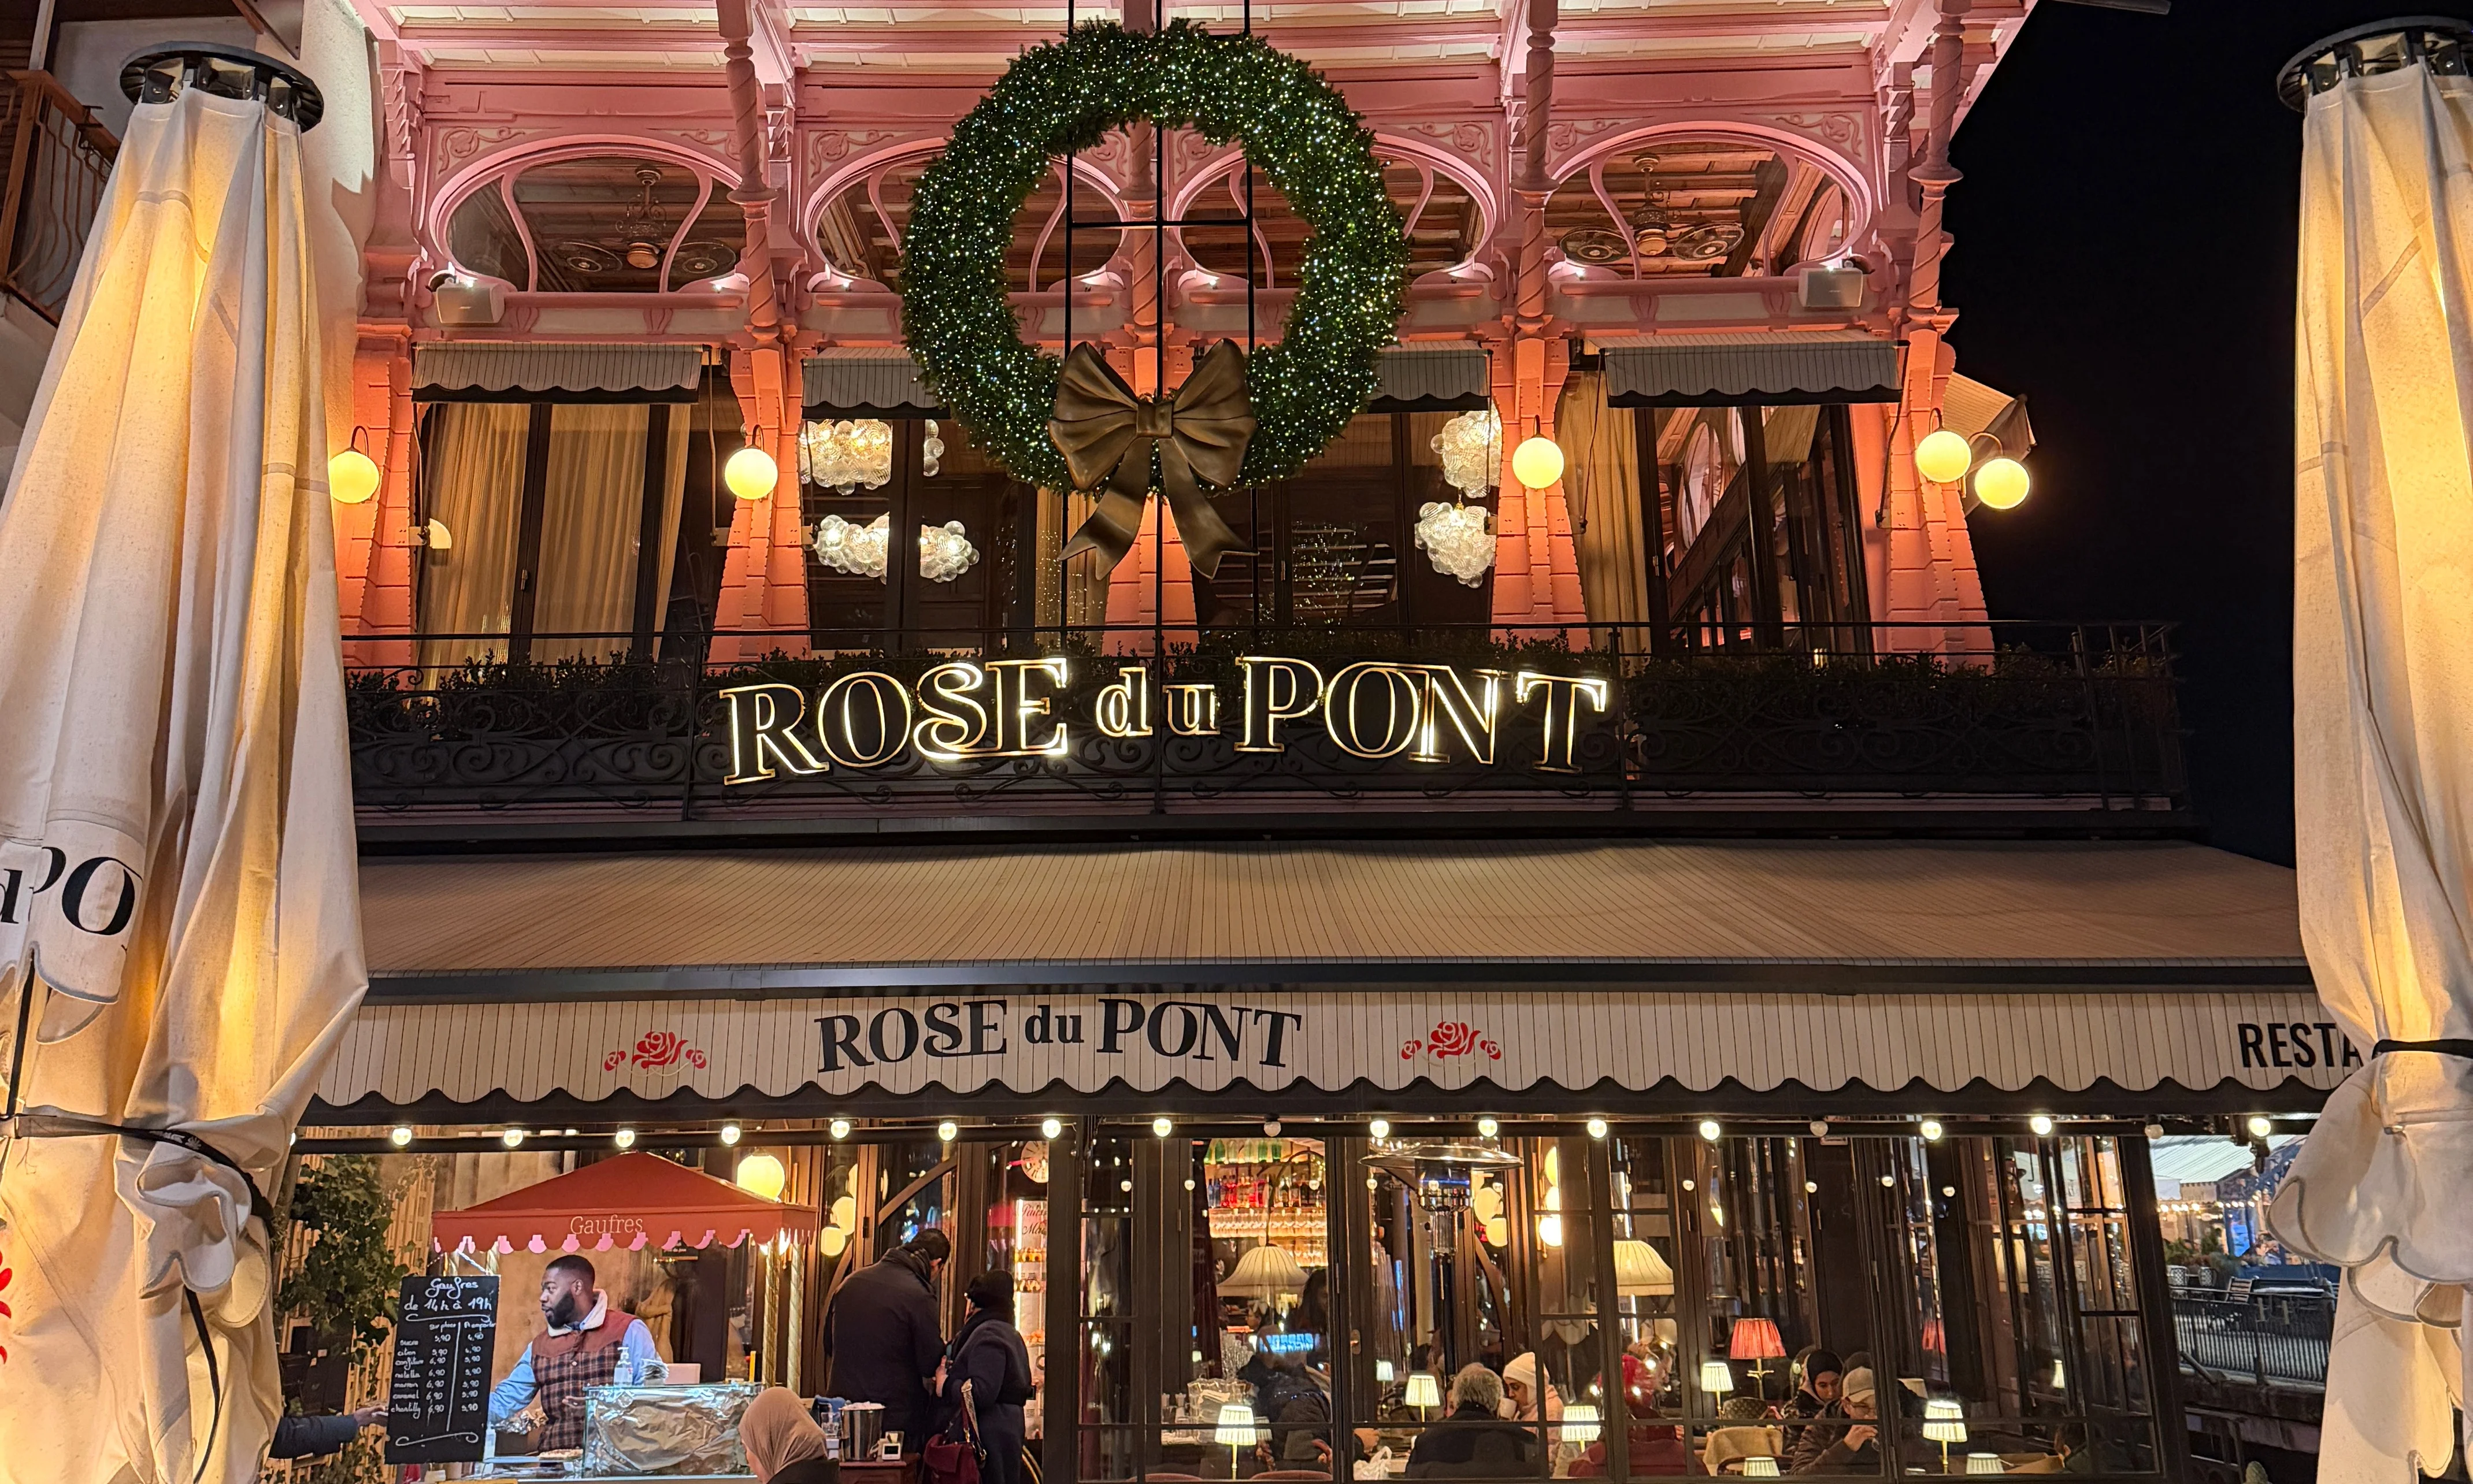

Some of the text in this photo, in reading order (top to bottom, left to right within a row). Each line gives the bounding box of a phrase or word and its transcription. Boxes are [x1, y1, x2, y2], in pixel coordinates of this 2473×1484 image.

[720, 656, 1608, 786] ROSE du PONT
[29, 847, 143, 936] PO
[814, 999, 1302, 1073] ROSE du PONT
[2237, 1023, 2364, 1069] RESTA
[570, 1214, 643, 1234] Gaufres
[404, 1294, 419, 1311] de
[468, 1296, 492, 1311] 19h
[425, 1277, 479, 1299] Gaufres
